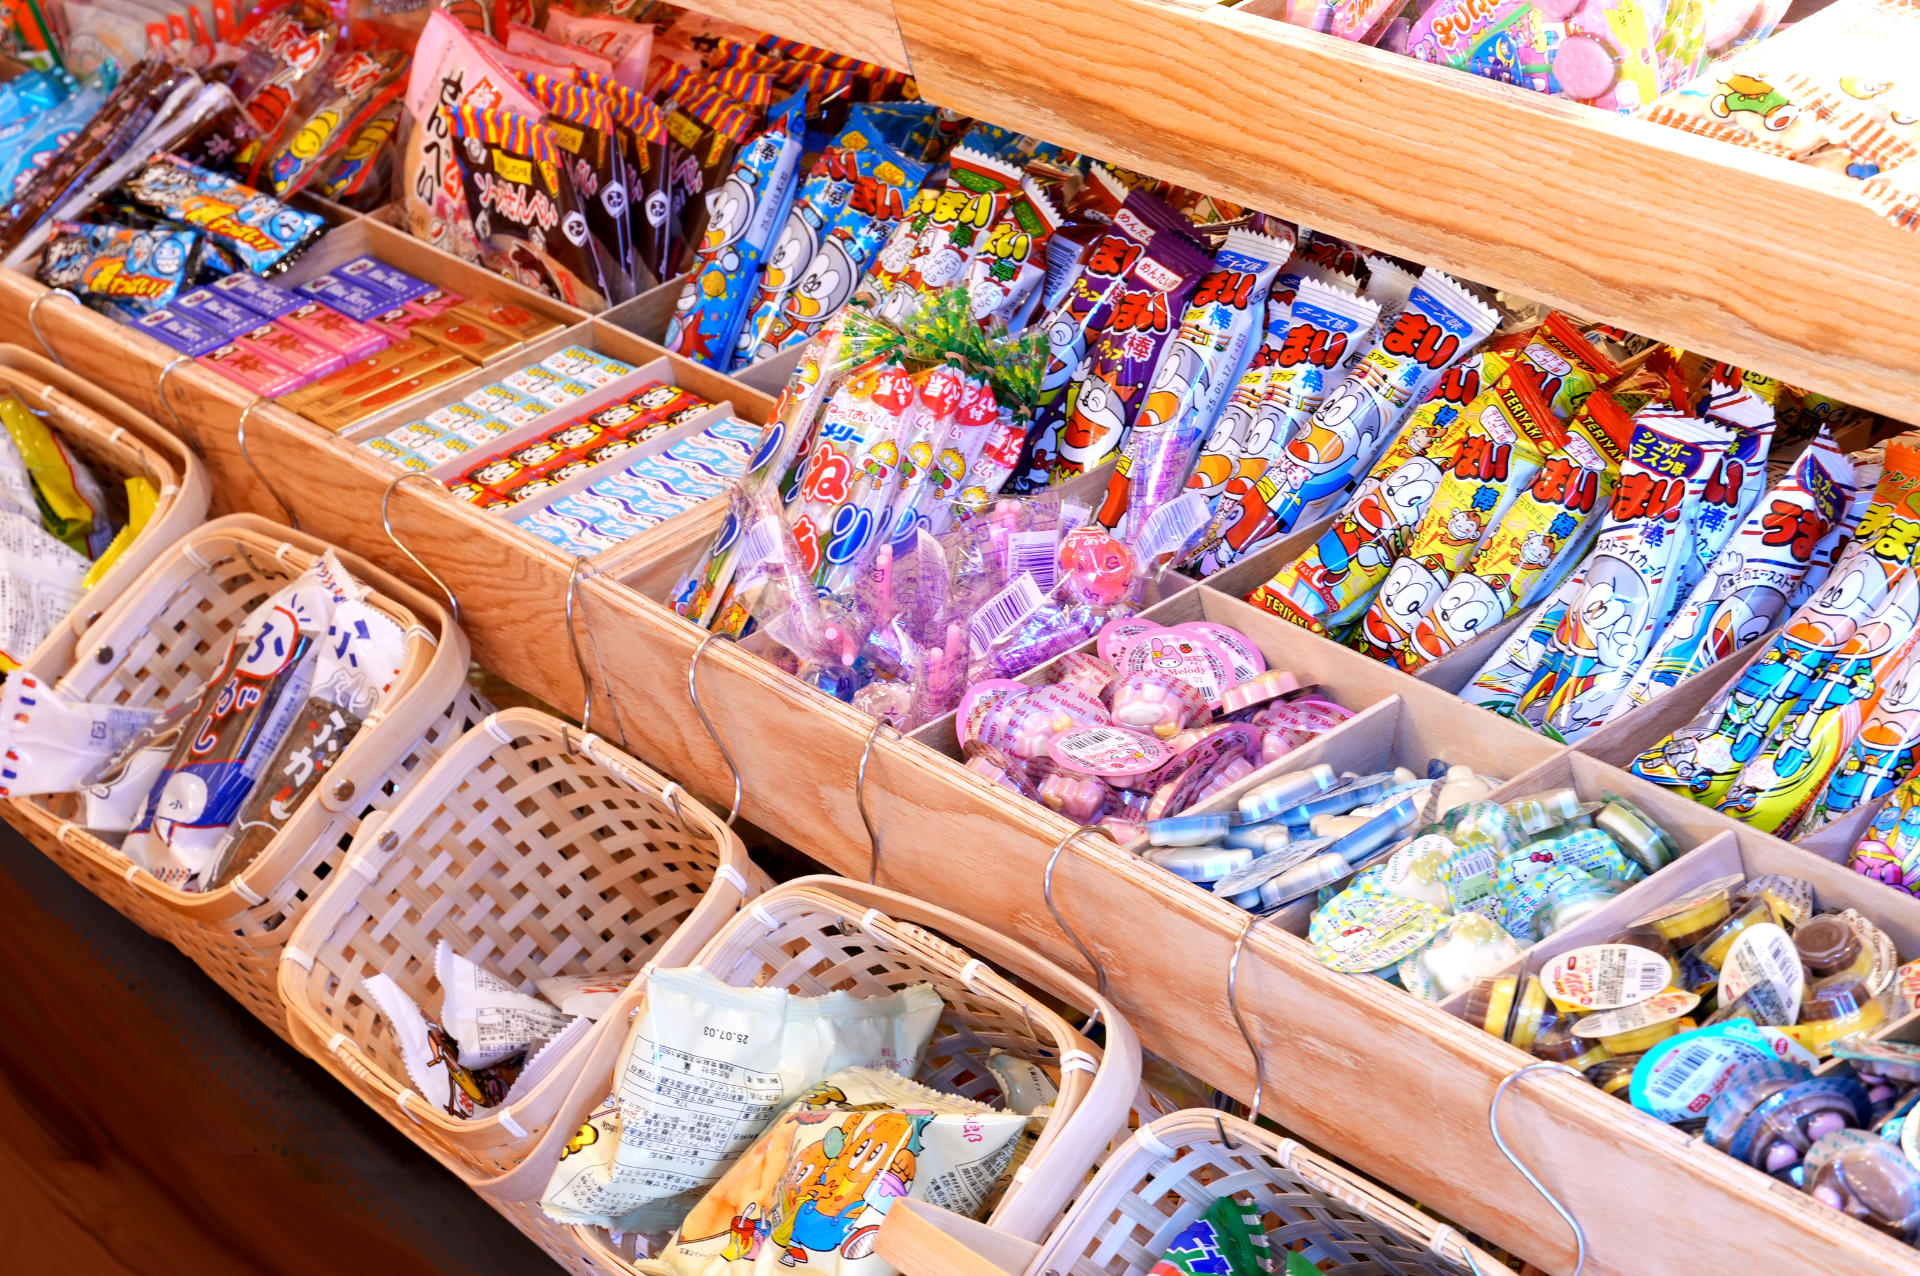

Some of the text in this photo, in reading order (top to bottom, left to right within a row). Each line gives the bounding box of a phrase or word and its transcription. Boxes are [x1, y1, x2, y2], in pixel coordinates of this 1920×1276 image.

[823, 183, 847, 206] 棒
[951, 223, 973, 247] 棒
[1192, 271, 1256, 310] まい
[1209, 305, 1233, 330] 棒
[1413, 294, 1465, 332] チーズ味
[1124, 333, 1154, 361] 棒
[1279, 324, 1348, 369] まい
[1384, 312, 1459, 370] まい
[1545, 336, 1595, 374] TERIYAKI
[1301, 367, 1324, 393] 棒
[1398, 361, 1423, 388] 棒
[1434, 404, 1458, 427] 棒
[1488, 409, 1515, 435] テリヤキ
[1502, 390, 1544, 440] TERIYAKI
[820, 422, 865, 444] メリー
[1583, 414, 1625, 463] TERIYAK
[1640, 431, 1692, 458] シュガー
[673, 439, 721, 467] ヨーグルト
[1631, 444, 1686, 476] ラスク味
[637, 457, 682, 483] ヨーグルト
[597, 477, 642, 502] ヨーグルト
[1473, 485, 1500, 512] 棒
[1532, 458, 1597, 514] まい
[1613, 472, 1685, 523] まい
[556, 501, 601, 519] ヨーグルト
[1699, 505, 1727, 533] 棒
[518, 520, 561, 538] ヨーグルト
[1550, 512, 1578, 540] 棒
[1297, 563, 1314, 581] FAST
[1265, 594, 1311, 630] TERIYAKI
[1168, 666, 1206, 676] Melody
[1060, 698, 1086, 715] Melody
[703, 1026, 748, 1044] 25.07.03
